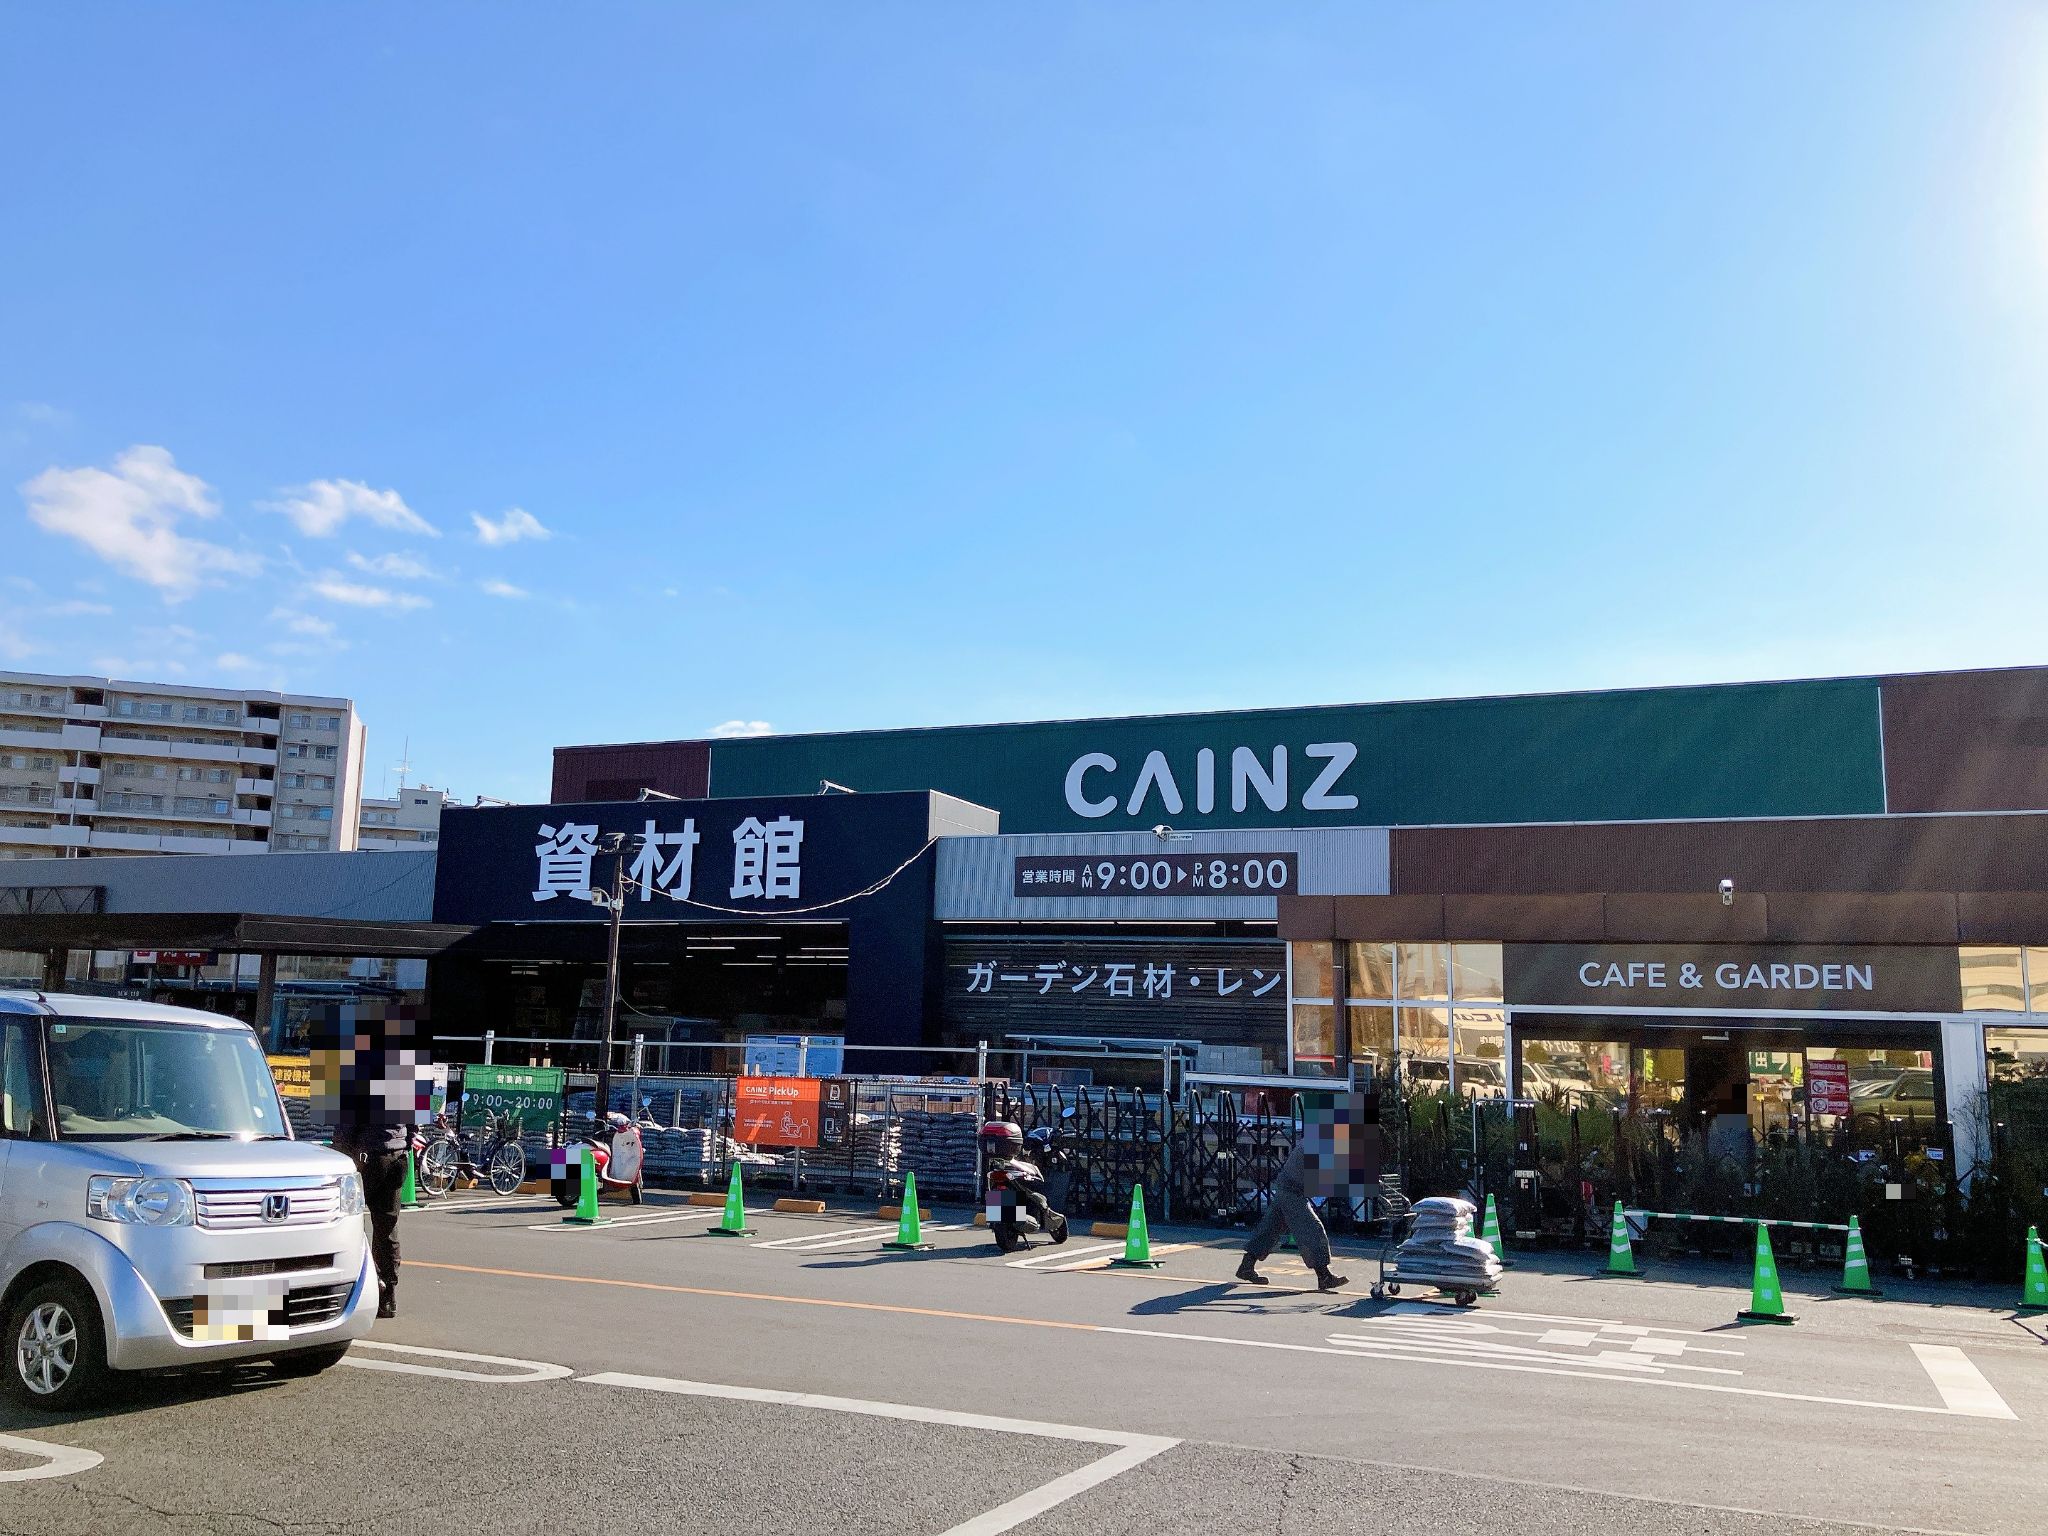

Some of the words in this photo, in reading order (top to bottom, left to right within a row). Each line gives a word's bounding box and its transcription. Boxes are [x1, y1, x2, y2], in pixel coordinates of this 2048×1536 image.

[1064, 742, 1359, 818] CAINZ
[532, 816, 804, 902] 資材館
[1022, 869, 1075, 885] 営業時間
[1097, 860, 1172, 890] 9:00
[1208, 859, 1288, 890] 8:00
[1579, 962, 1667, 989] CAFE
[1678, 962, 1704, 989] &
[1714, 962, 1873, 991] GARDEN
[768, 1086, 800, 1098] PickUp
